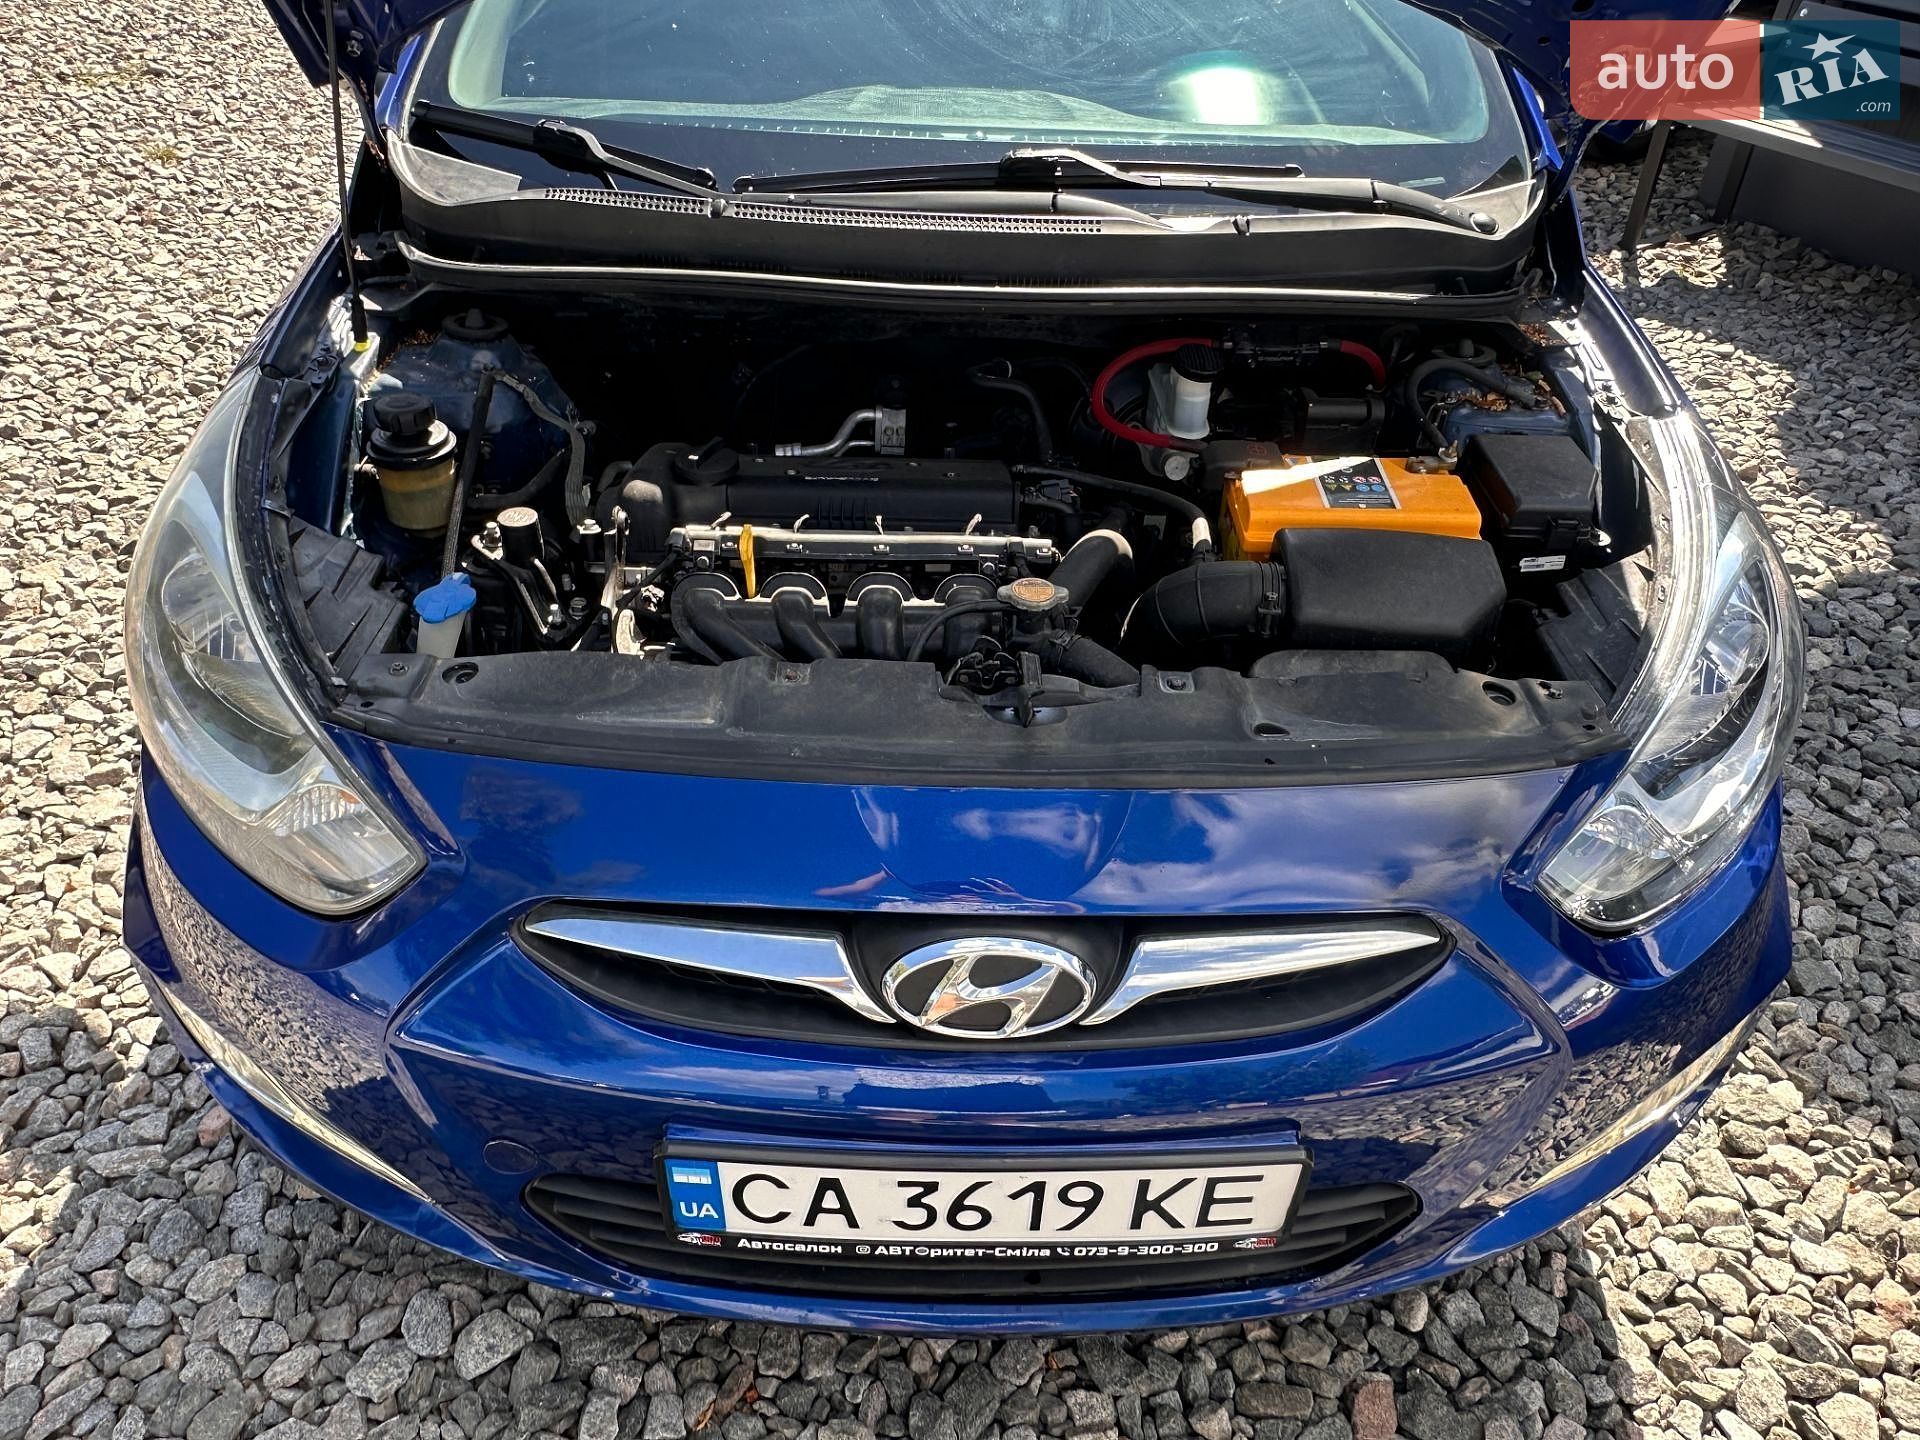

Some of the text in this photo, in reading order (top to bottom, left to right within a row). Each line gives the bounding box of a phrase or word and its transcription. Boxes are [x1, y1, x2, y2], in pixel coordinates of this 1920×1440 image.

[679, 1201, 719, 1219] UA
[731, 1173, 1264, 1231] CA 3619 KE
[737, 1238, 842, 1254] Автосалон
[1073, 1242, 1219, 1256] 073-9-300-300
